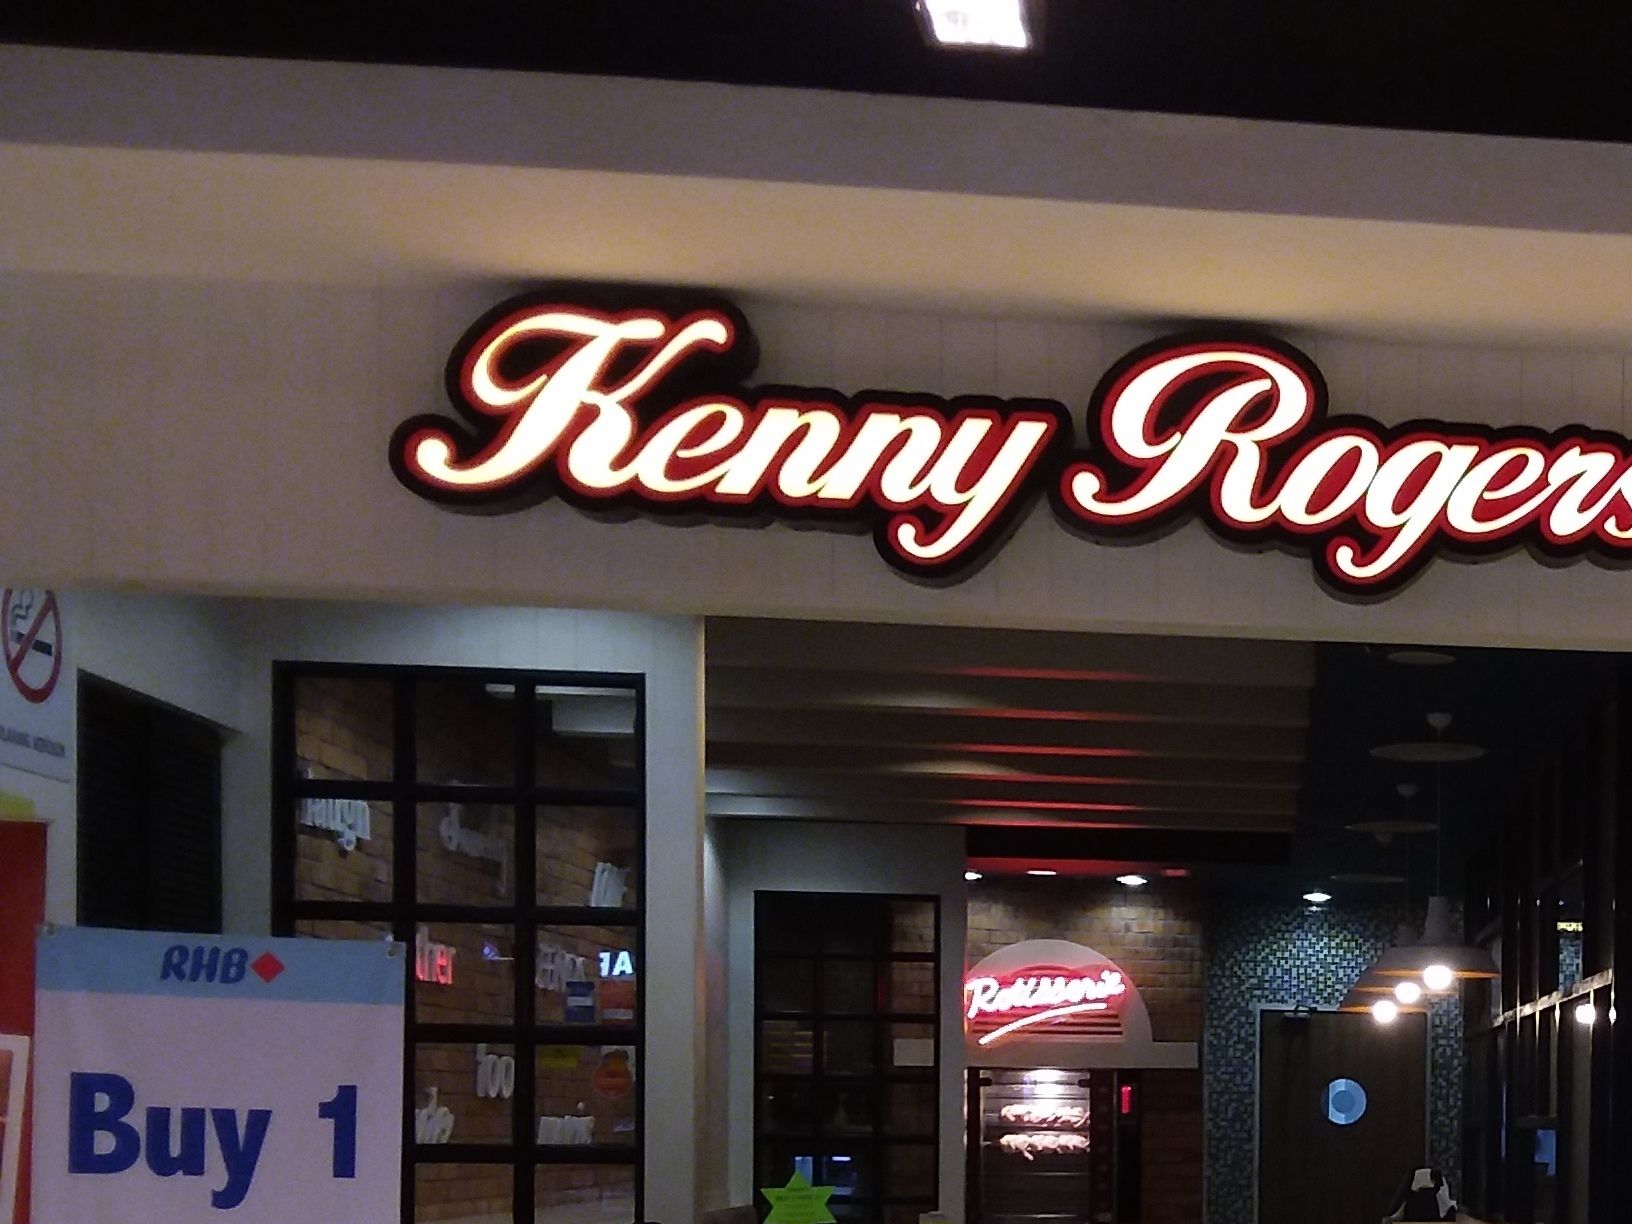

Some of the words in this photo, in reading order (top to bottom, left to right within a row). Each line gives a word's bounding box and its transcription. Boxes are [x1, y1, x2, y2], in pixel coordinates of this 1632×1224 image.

[403, 302, 1060, 566] Kenny
[160, 944, 249, 984] RHB
[67, 1071, 273, 1210] Buy
[318, 1084, 358, 1179] 1
